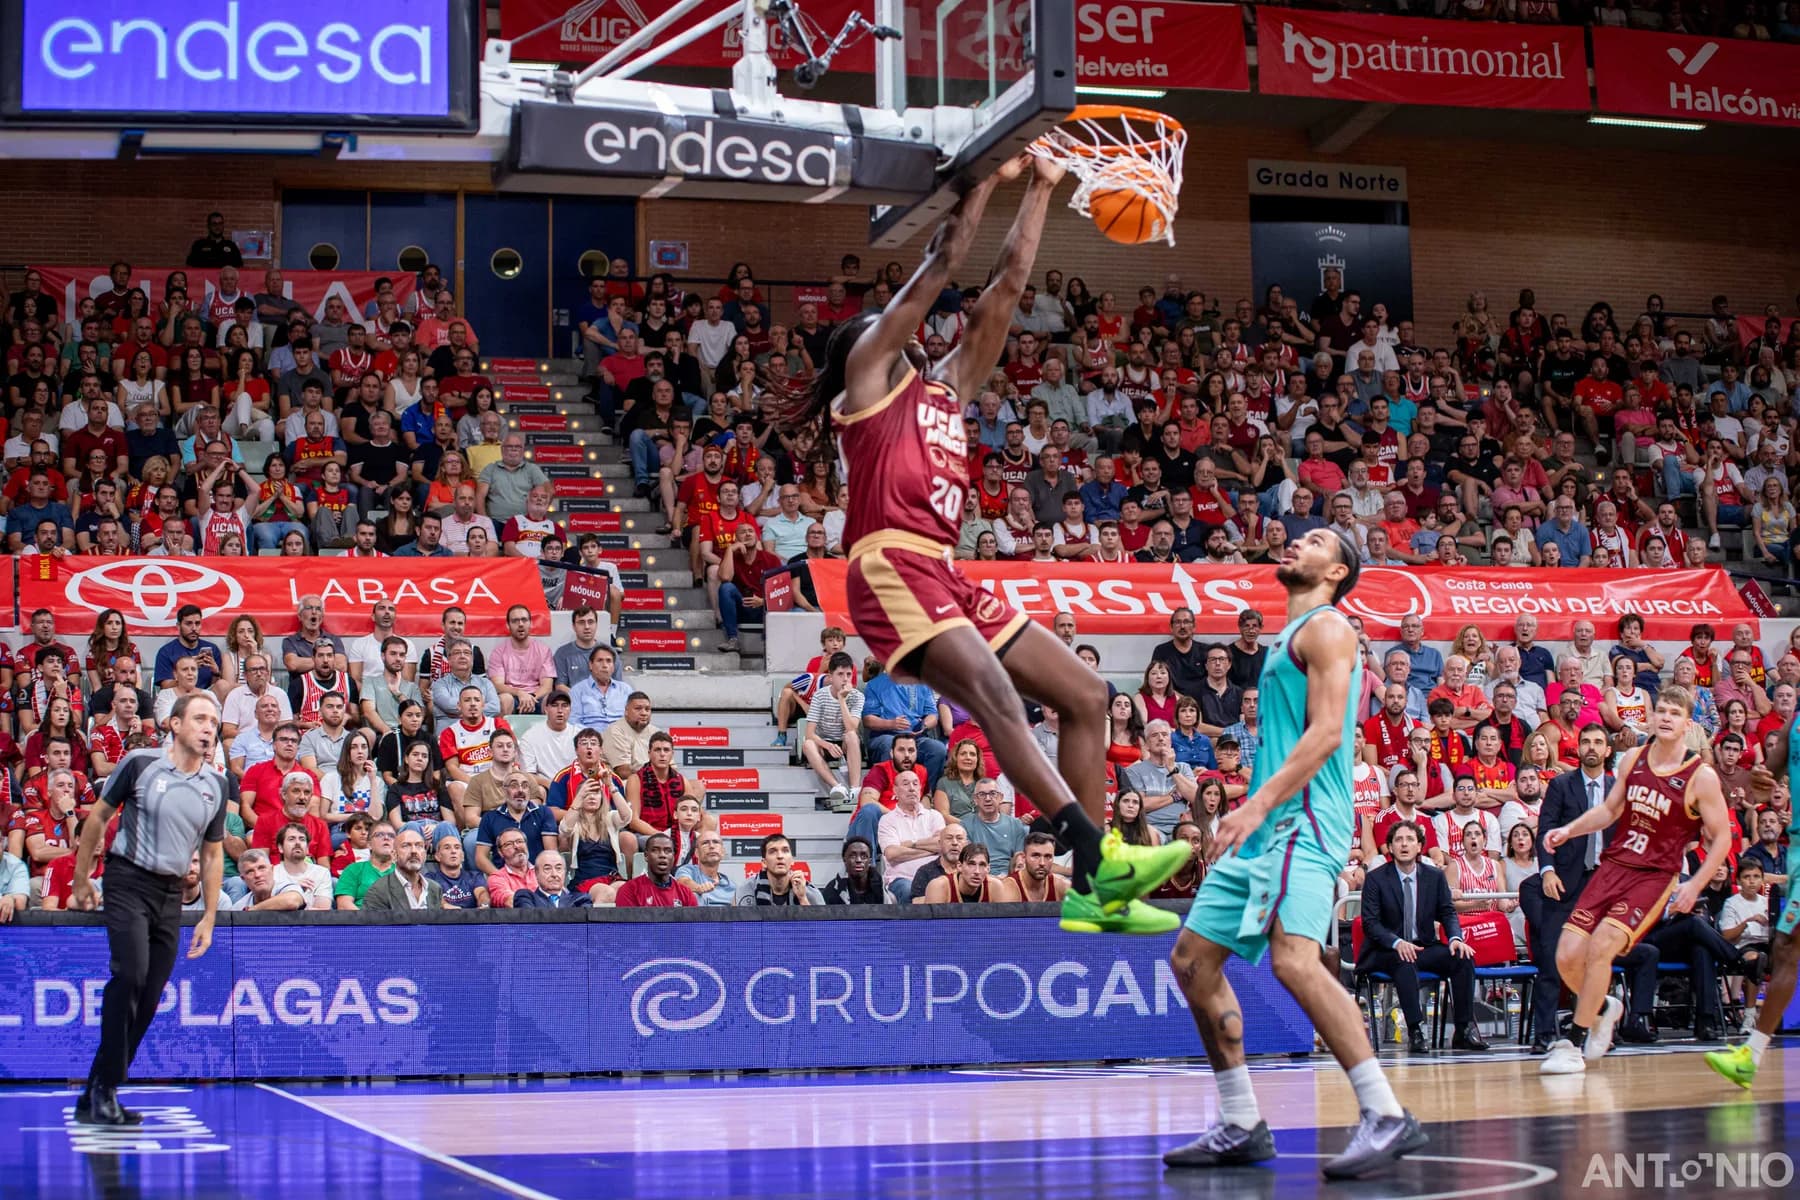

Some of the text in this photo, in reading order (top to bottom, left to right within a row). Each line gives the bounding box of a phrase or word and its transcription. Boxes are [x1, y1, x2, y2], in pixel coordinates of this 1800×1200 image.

[42, 2, 431, 85] endesa
[1337, 35, 1565, 80] patrimonial
[1669, 81, 1778, 117] Halcón
[583, 119, 837, 187] endesa
[1256, 167, 1400, 191] Grada Norte
[300, 449, 333, 460] UCAM
[929, 475, 963, 521] 20
[288, 577, 501, 607] LABASA
[570, 585, 601, 599] MÓDULO
[769, 584, 790, 599] MÓDULO
[1445, 579, 1487, 591] Costa
[1450, 593, 1562, 615] REGIÓN
[1611, 598, 1723, 616] MURCIA
[1627, 785, 1673, 815] UCAM
[1471, 921, 1496, 933] UCAM
